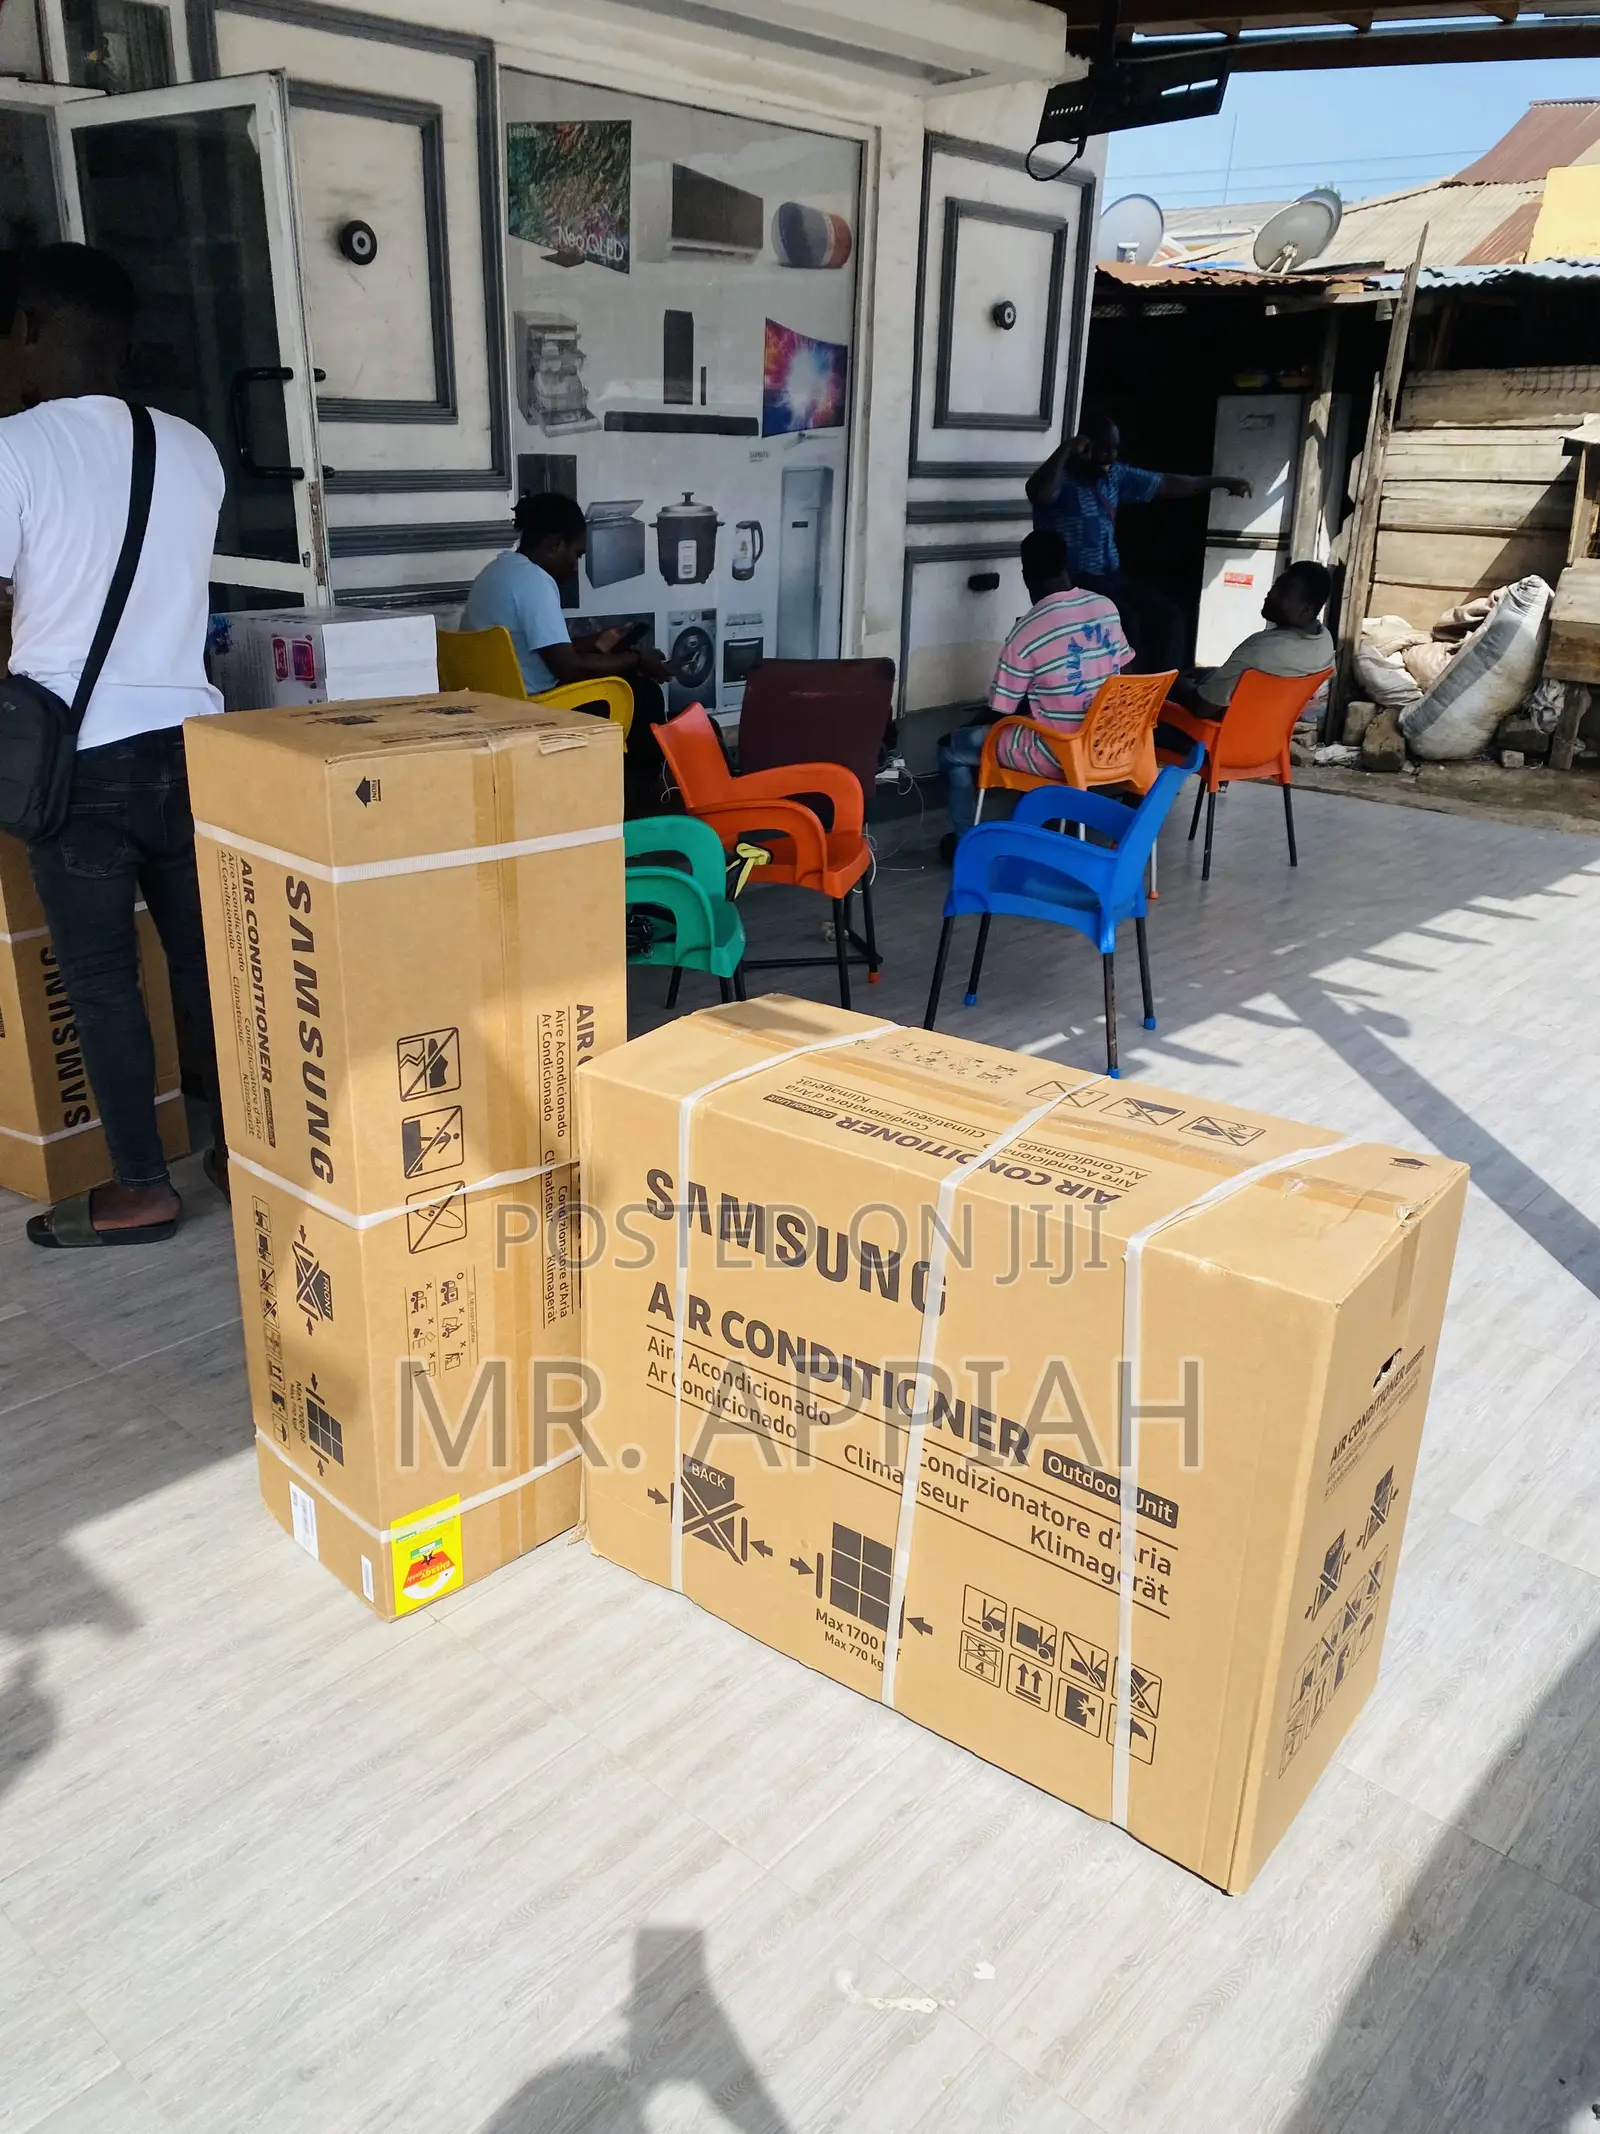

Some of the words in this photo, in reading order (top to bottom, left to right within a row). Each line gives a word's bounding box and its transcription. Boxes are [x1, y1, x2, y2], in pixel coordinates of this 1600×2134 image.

[220, 849, 227, 864] Ar
[228, 852, 236, 879] Aire
[240, 857, 256, 905] AIR
[221, 866, 236, 949] Condicionado
[231, 882, 245, 972] Acondicionado
[246, 908, 272, 1084] CONDITIONER
[40, 946, 92, 1128] SAMSUNG
[285, 874, 335, 1185] SAMSUNG
[541, 1013, 551, 1028] Ar
[555, 1010, 565, 1037] Aire
[575, 1004, 595, 1053] AIR
[541, 1030, 553, 1122] Condicionado
[555, 1040, 567, 1138] Acondicionado
[790, 1102, 834, 1119] Outdoor
[825, 1095, 930, 1132] Condizionatore
[901, 1109, 987, 1139] Climatiseur
[836, 1116, 1052, 1186] CONDITIONER
[983, 1143, 1100, 1178] Acondicionao
[1017, 1142, 1124, 1175] Condicionado
[1055, 1179, 1122, 1205] AIR
[1101, 1174, 1139, 1189] Aire
[1124, 1171, 1148, 1180] Ar
[557, 1185, 569, 1280] Condizionatore
[646, 1168, 947, 1318] SAMSUNG
[321, 1273, 332, 1317] FRONT
[647, 1281, 712, 1337] AR
[720, 1310, 1030, 1468] CONDITIONER
[1047, 1455, 1124, 1499] Outdoo
[647, 1361, 668, 1384] Ar
[843, 1443, 970, 1513] Climaseur
[647, 1336, 683, 1362] Air
[687, 1352, 832, 1426] Acondicionado
[1098, 1527, 1172, 1577] d'ria
[1330, 1434, 1347, 1466] AIR
[691, 1463, 727, 1490] BACK
[815, 1607, 843, 1634] Max
[846, 1623, 879, 1650] 1700
[824, 1631, 847, 1651] Max
[848, 1642, 868, 1661] 770
